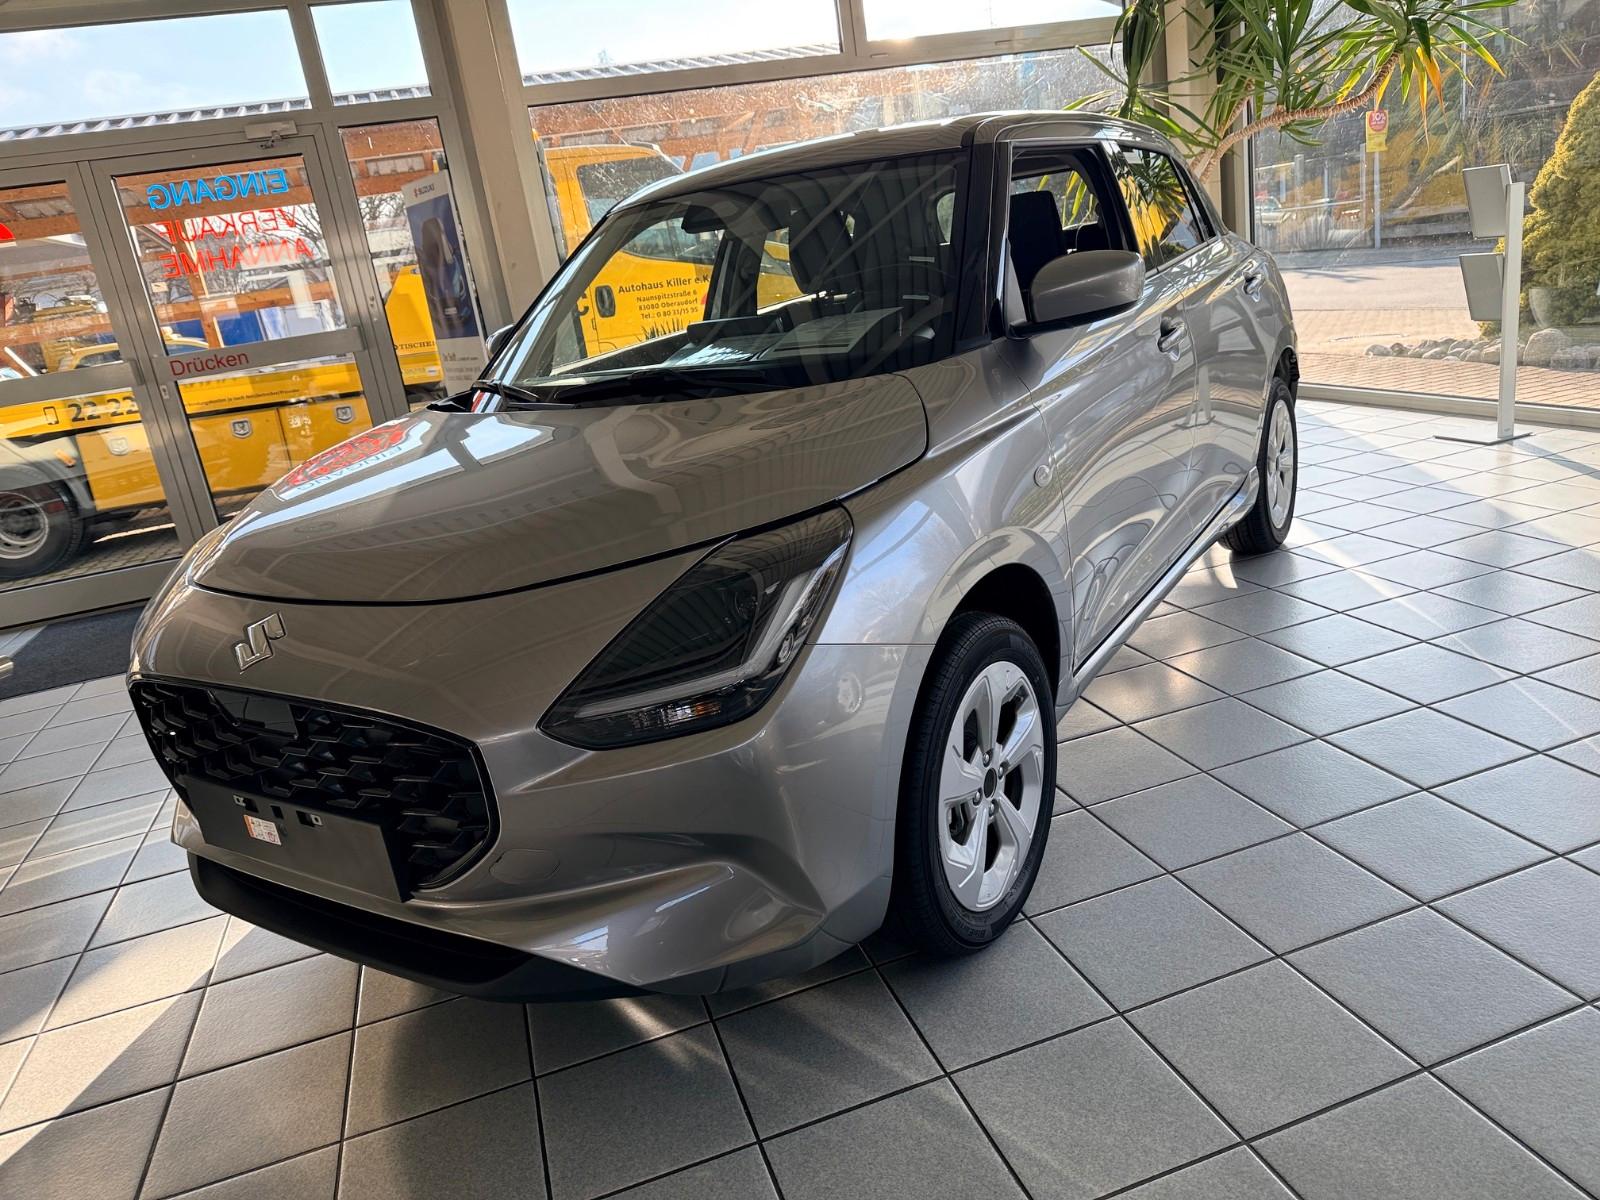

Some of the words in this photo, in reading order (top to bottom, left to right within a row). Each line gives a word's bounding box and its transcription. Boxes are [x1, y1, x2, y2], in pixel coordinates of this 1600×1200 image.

[618, 282, 664, 294] Autohaus
[666, 277, 692, 288] Killer
[636, 290, 691, 303] Naunspitzstraße
[661, 298, 698, 308] Oberaudorf
[169, 352, 250, 376] Drücken
